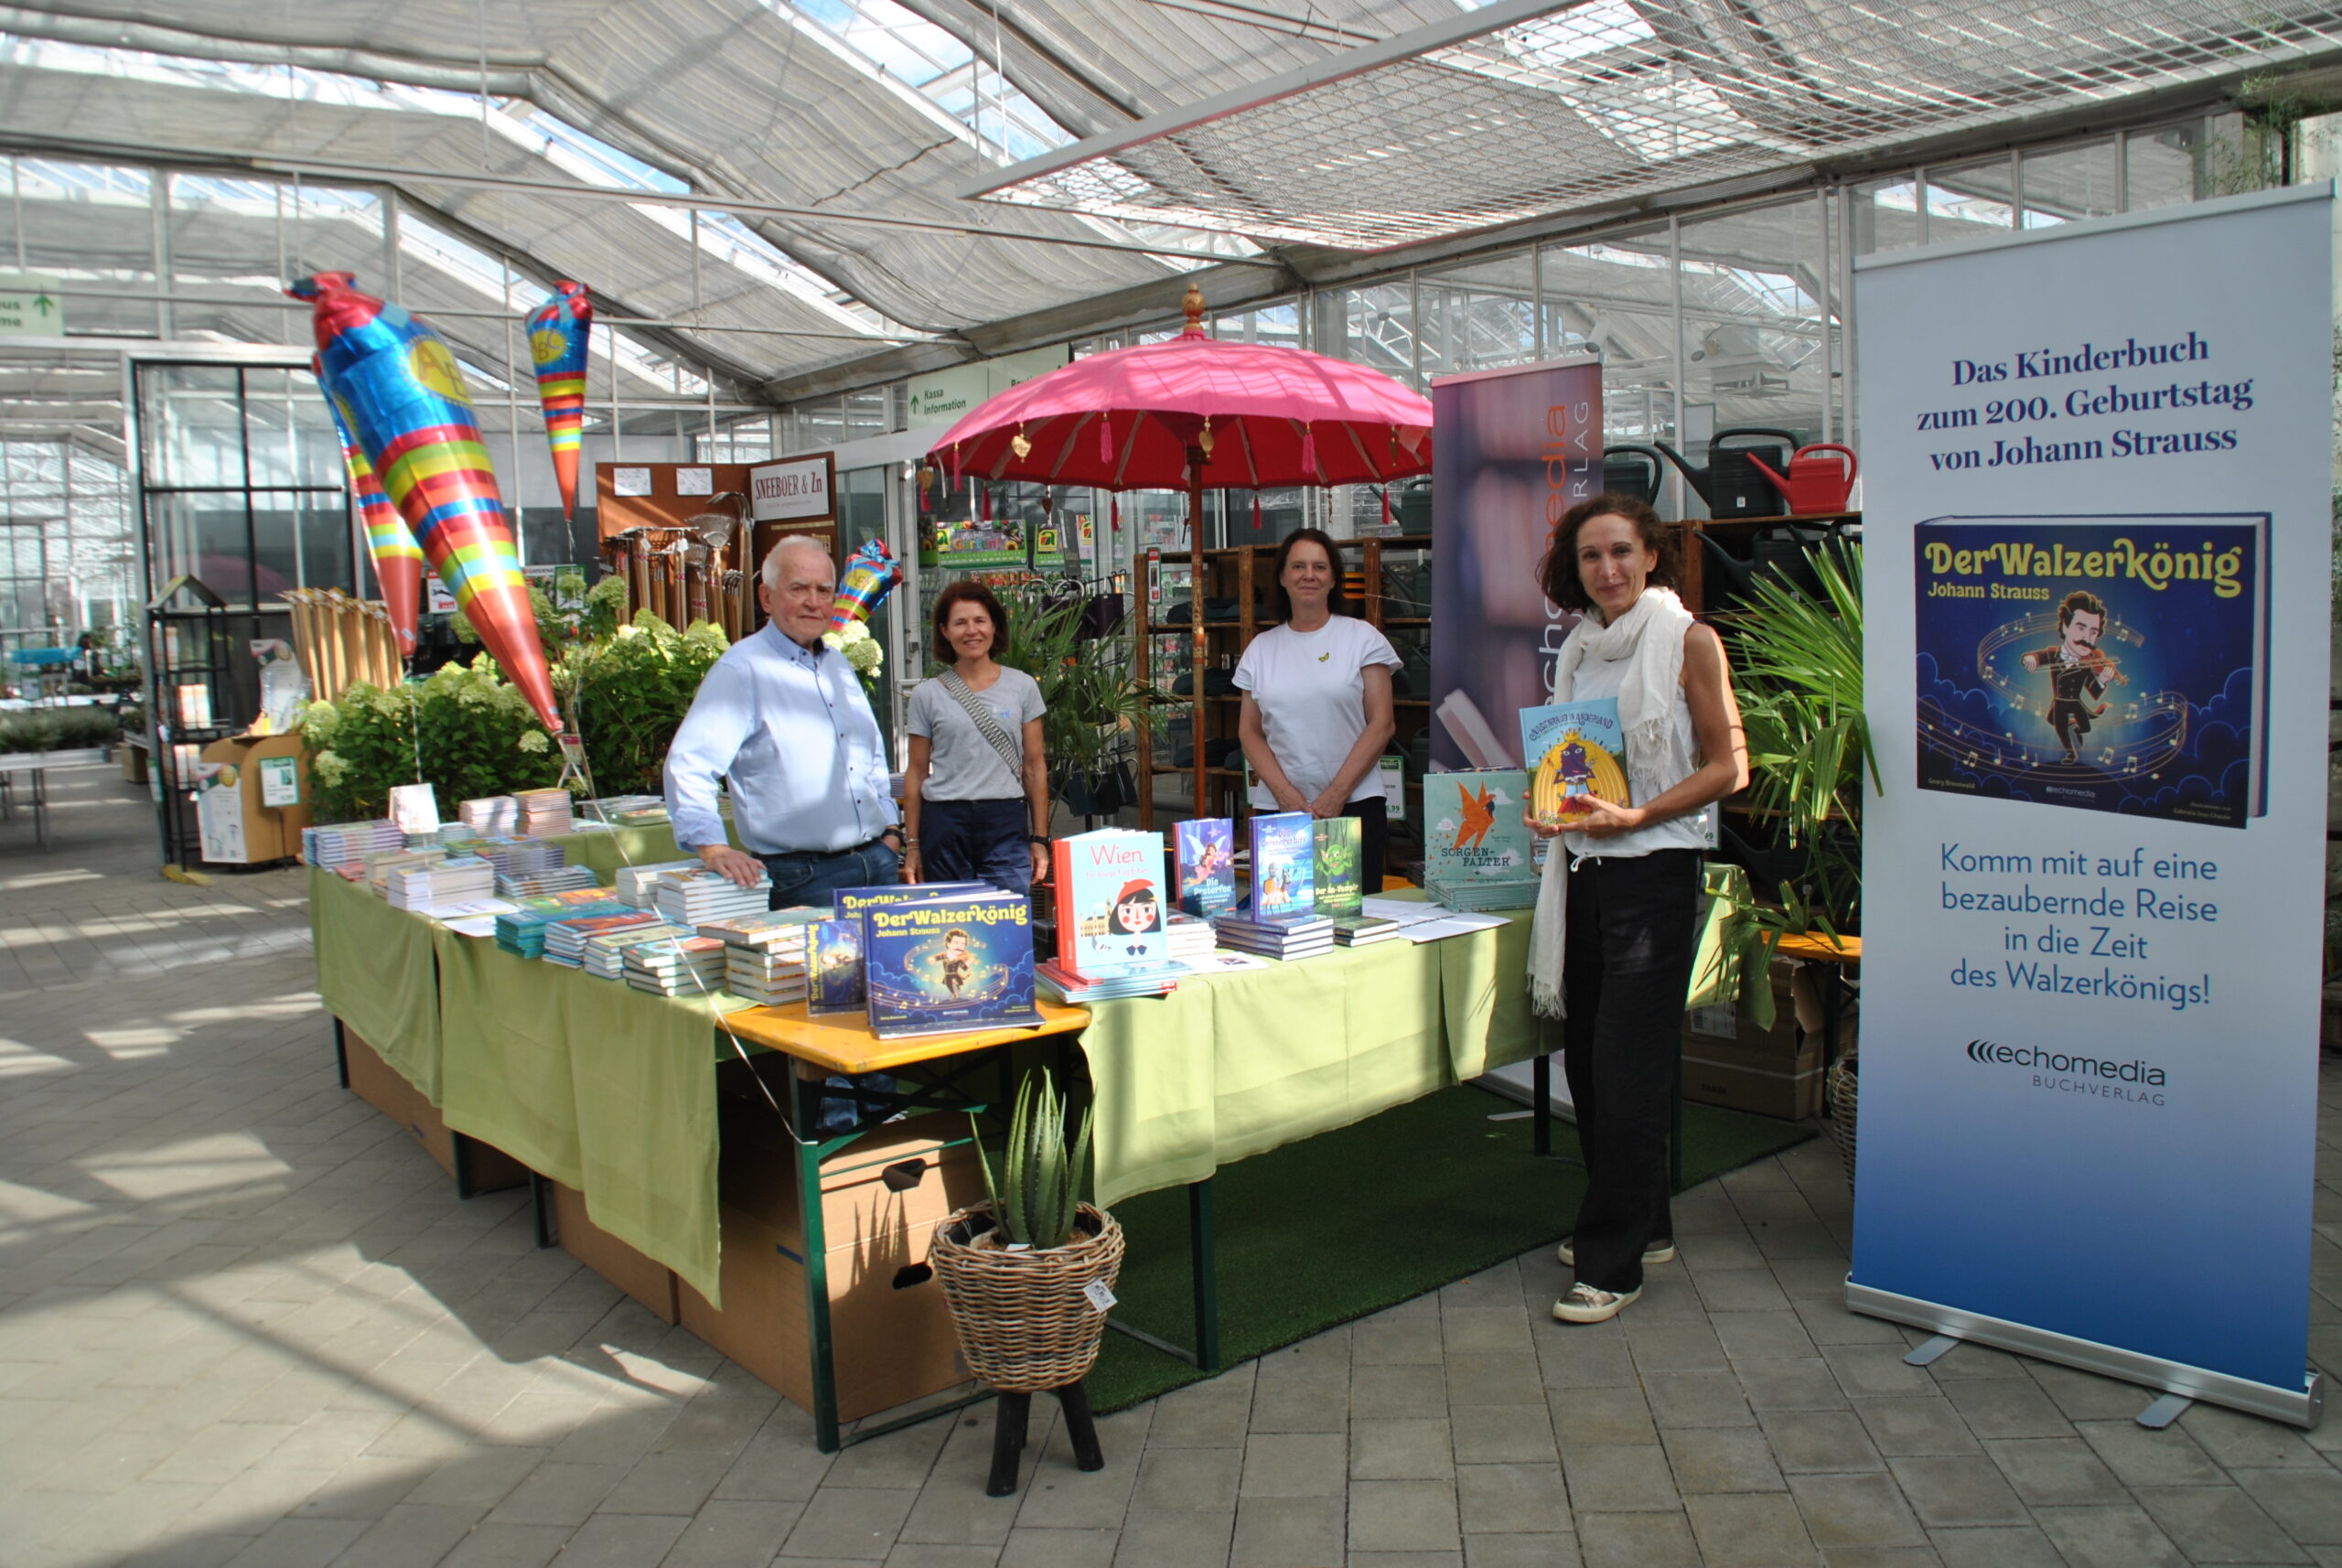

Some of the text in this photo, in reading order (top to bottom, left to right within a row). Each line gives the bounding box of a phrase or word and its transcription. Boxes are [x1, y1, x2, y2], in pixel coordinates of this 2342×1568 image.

[1952, 331, 2209, 386] Das Kinderbuch
[924, 388, 943, 401] Kassa
[924, 399, 966, 415] Information
[1917, 378, 2254, 431] zum 200. Geburtstag
[1929, 428, 2238, 472] von Johann Strauss
[755, 471, 822, 499] SNEEBOER & Zn
[1928, 582, 2050, 601] Johann Strauss
[1090, 843, 1144, 865] Wien
[1441, 847, 1495, 857] SORGEN-
[1462, 857, 1509, 867] FALTER
[1940, 843, 2218, 881] Komm mit auf eine
[1941, 881, 2218, 922] bezaubernde Reise
[876, 928, 940, 938] Johann Strauss
[2004, 925, 2148, 959] in die Zeit
[1950, 958, 2211, 1011] des Walzerkönigs!
[1995, 1044, 2166, 1087] echomedia
[2032, 1074, 2166, 1108] BUCHVERLAG
